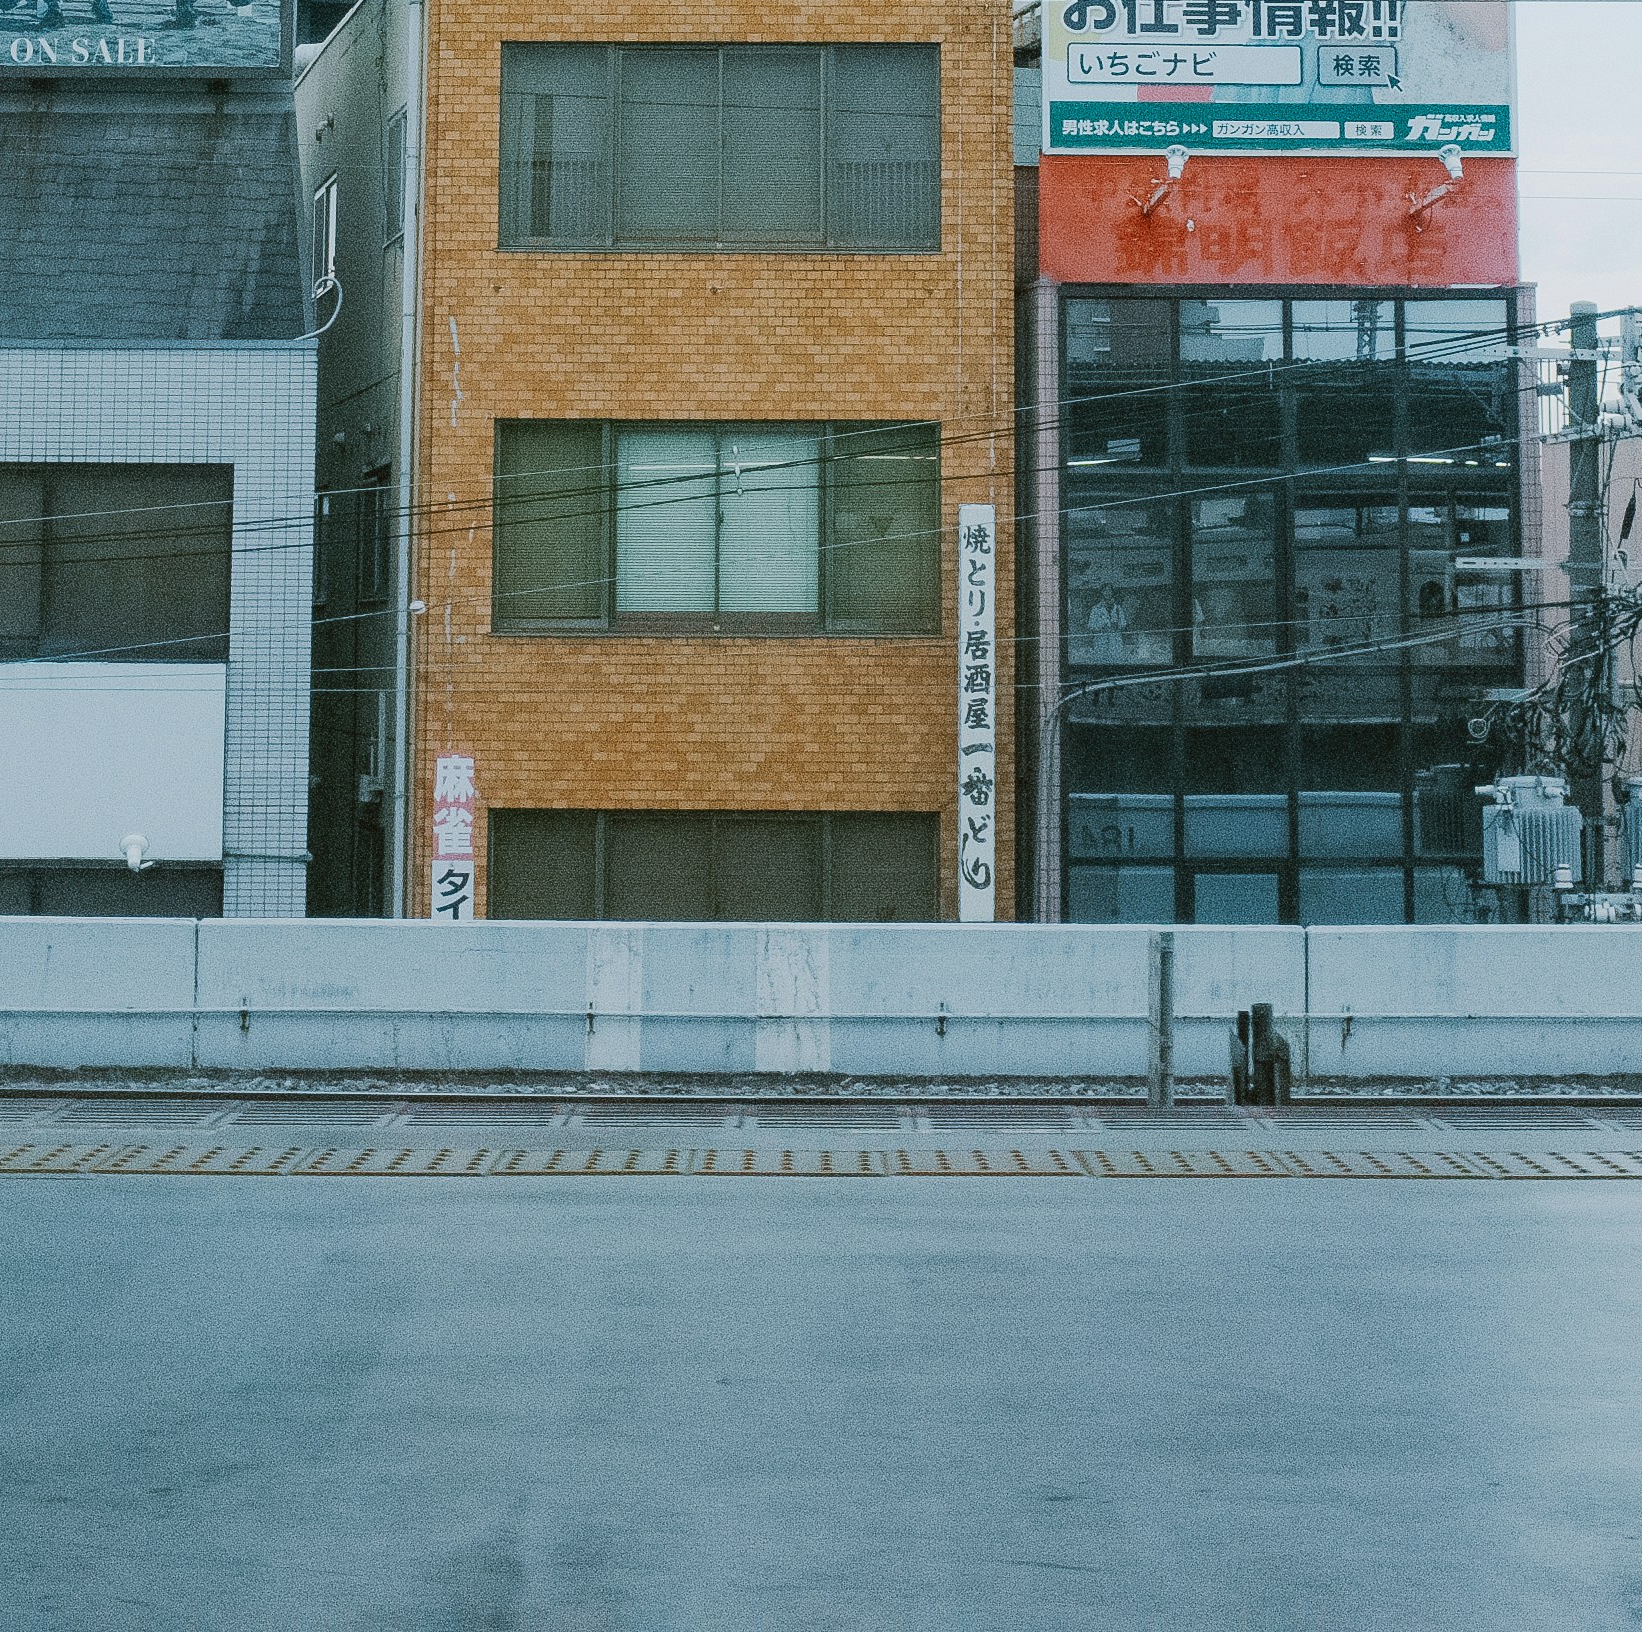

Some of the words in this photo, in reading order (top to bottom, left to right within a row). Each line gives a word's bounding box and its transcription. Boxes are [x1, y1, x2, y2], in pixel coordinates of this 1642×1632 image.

[10, 37, 59, 64] ON
[71, 37, 157, 64] SALE
[1079, 51, 1216, 77] いちごナビ
[1333, 54, 1382, 78] 検索
[1061, 120, 1180, 136] 男性求人はこちら
[1216, 123, 1305, 136] ガンガン高収入
